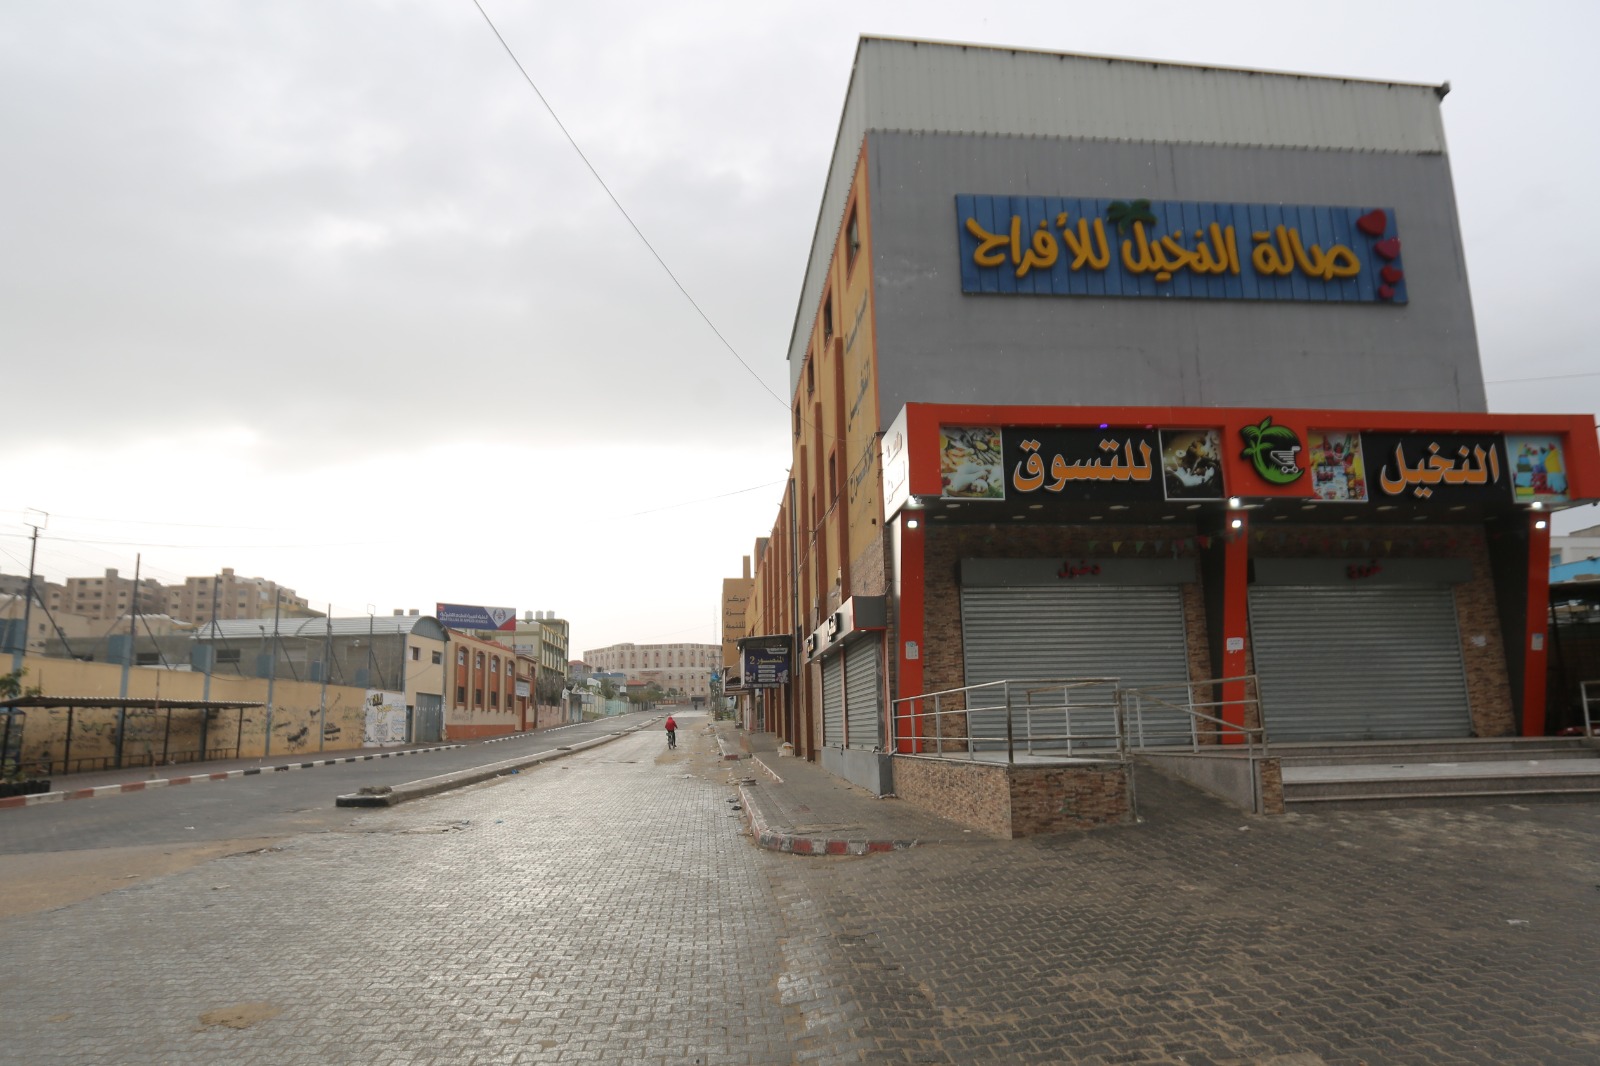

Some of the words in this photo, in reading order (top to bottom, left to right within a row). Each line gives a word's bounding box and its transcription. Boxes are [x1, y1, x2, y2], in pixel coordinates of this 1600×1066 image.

[965, 212, 1111, 279] للأفراح
[1121, 219, 1241, 282] النخيل
[1252, 223, 1361, 280] صالة
[1012, 438, 1153, 492] للتسوق
[1379, 440, 1500, 498] النخيل
[1057, 560, 1101, 578] دخول
[749, 655, 755, 665] 2
